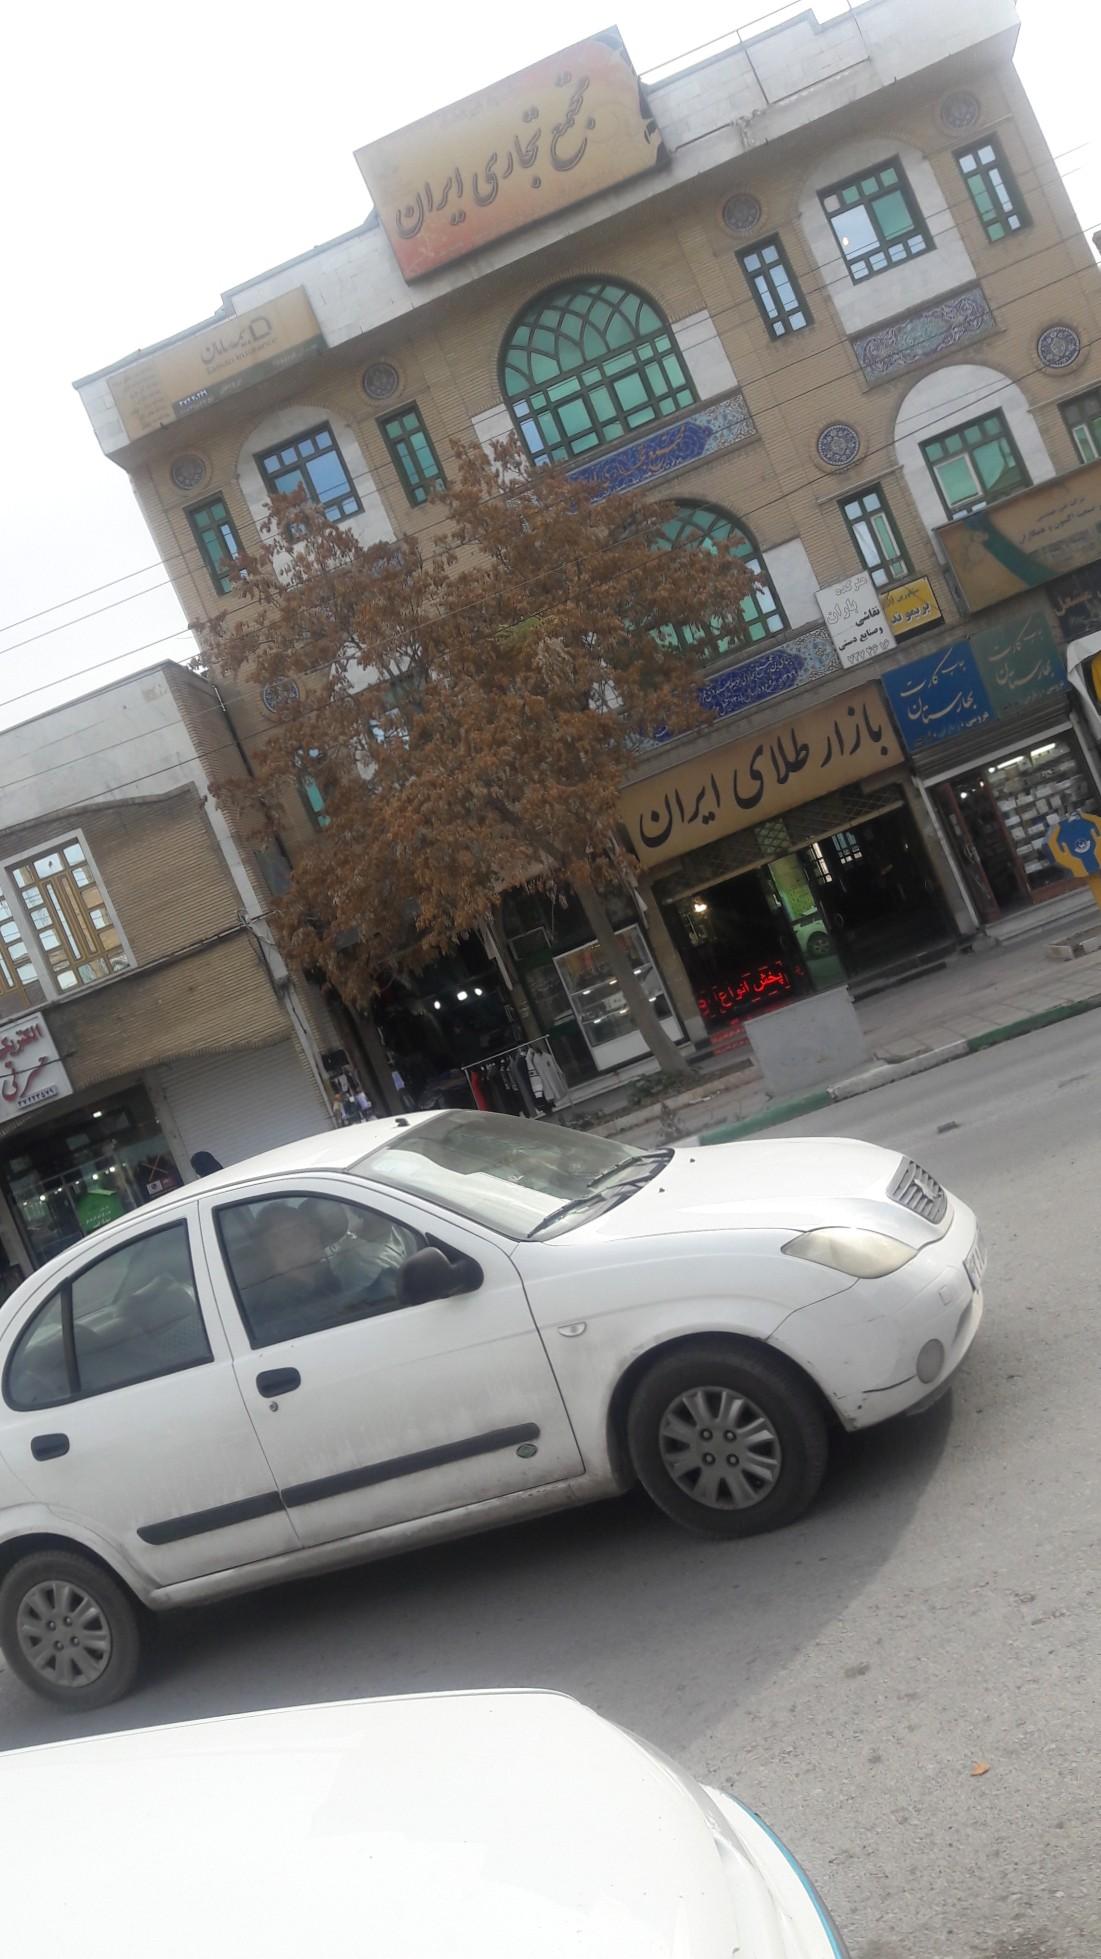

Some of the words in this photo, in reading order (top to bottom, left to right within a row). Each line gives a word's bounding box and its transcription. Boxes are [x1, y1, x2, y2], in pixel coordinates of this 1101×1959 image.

[551, 71, 596, 172] مجتمع
[472, 106, 542, 207] تجاری
[396, 167, 466, 240] ایران
[839, 636, 858, 651] دستی
[855, 607, 881, 627] نقاشی
[900, 648, 953, 697] کارت
[996, 659, 1055, 689] بهارستان
[820, 703, 889, 768] بازار
[907, 690, 977, 724] بهارستان
[733, 728, 809, 810] طلای
[639, 772, 721, 848] ایران
